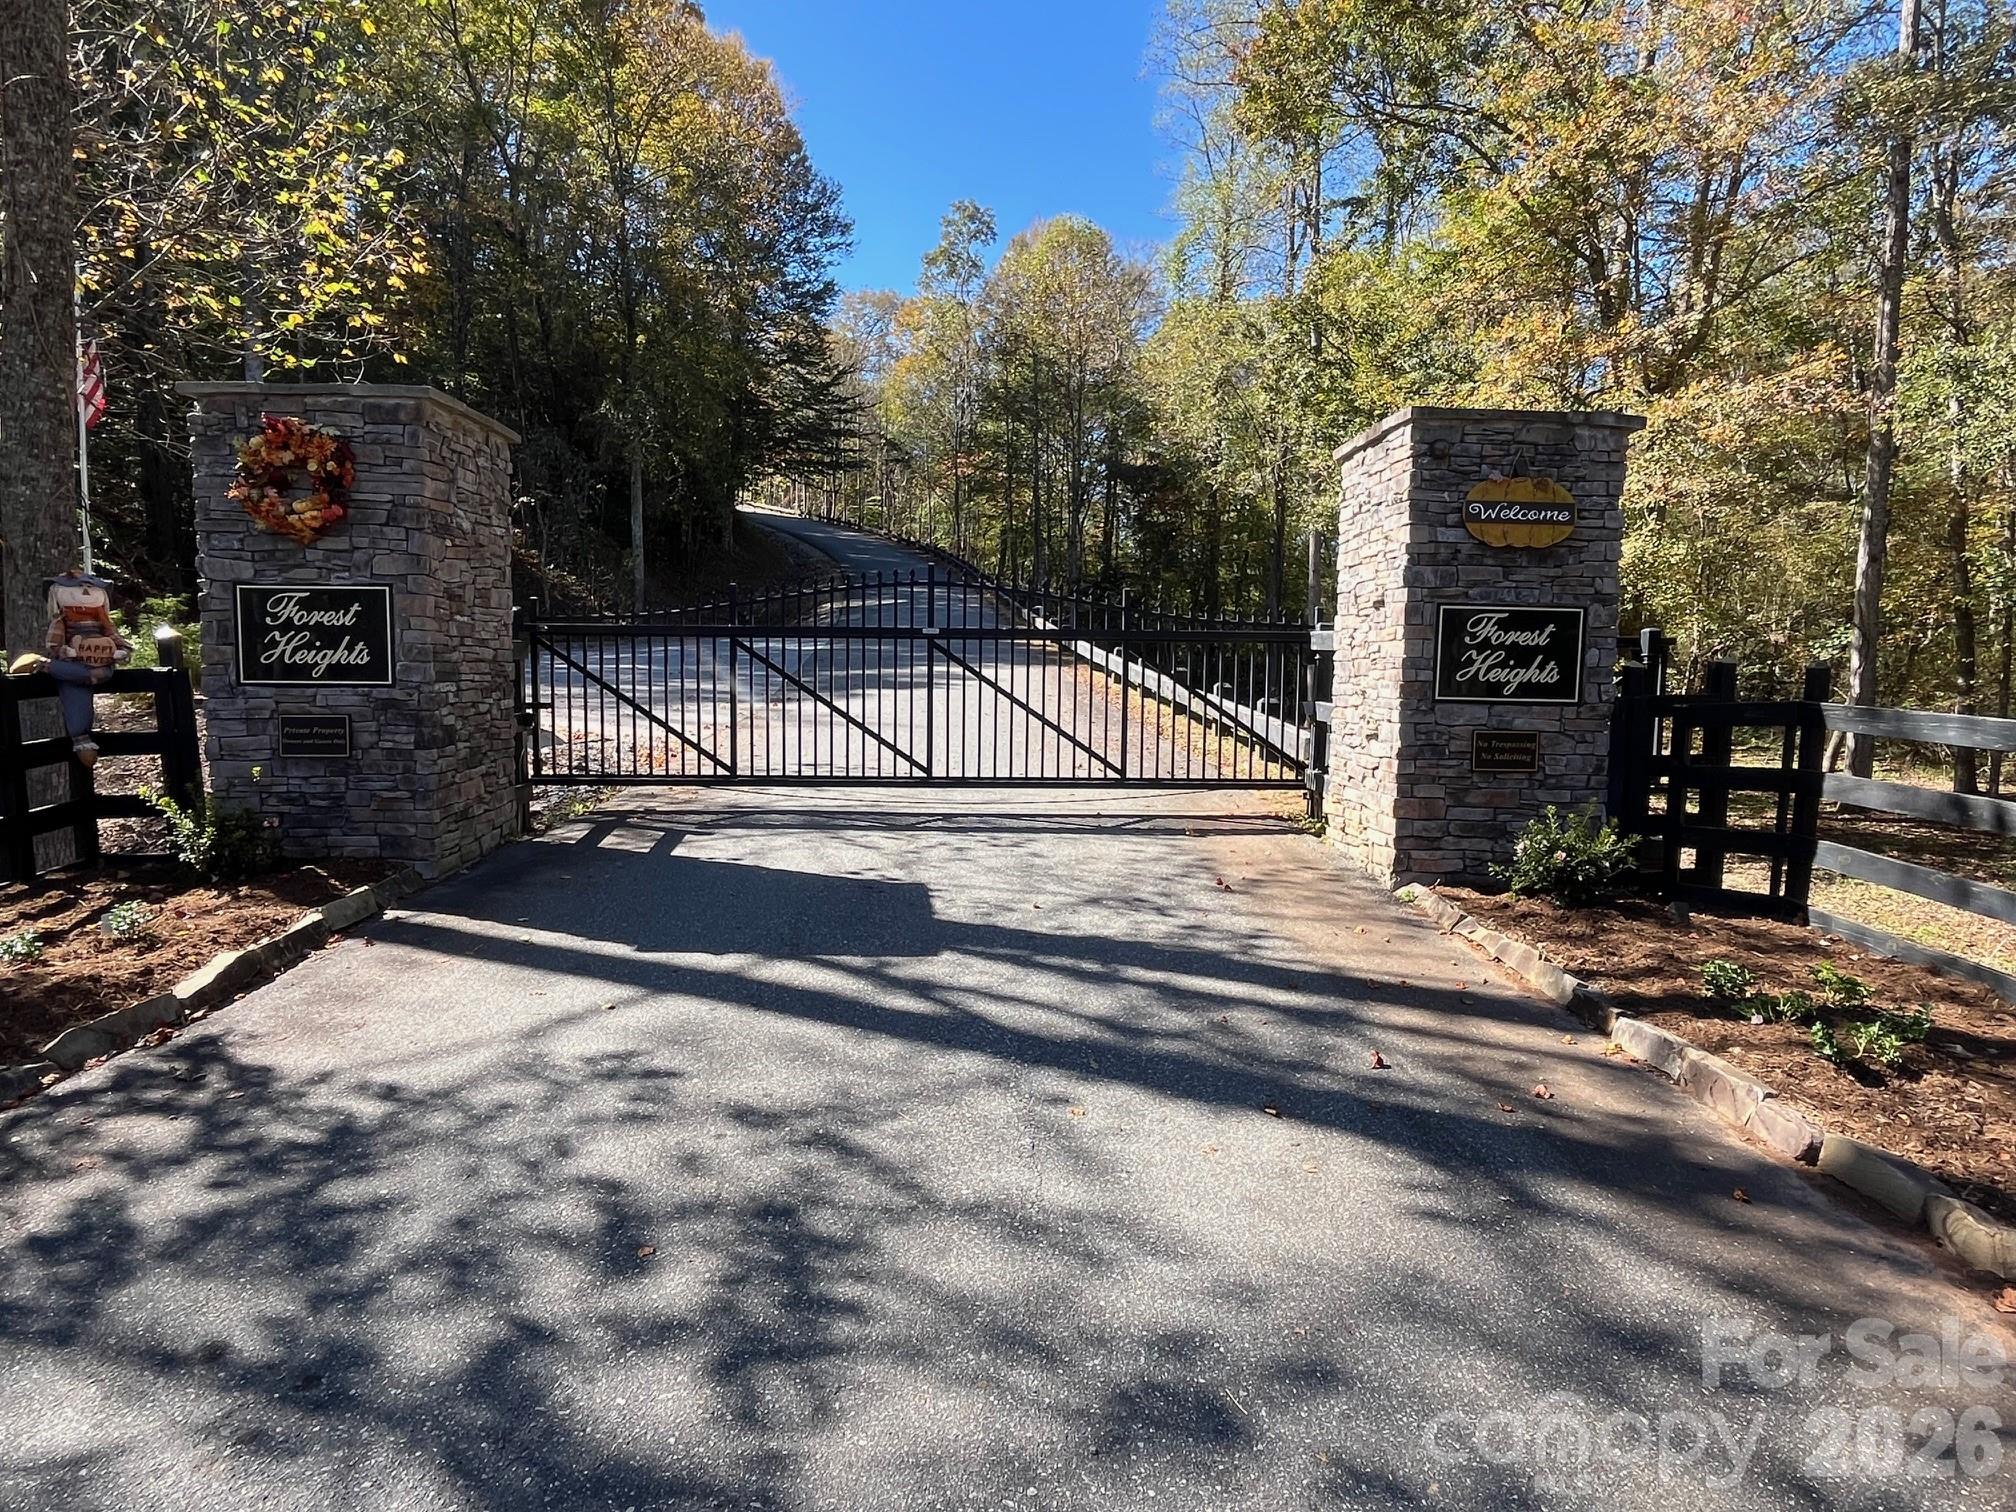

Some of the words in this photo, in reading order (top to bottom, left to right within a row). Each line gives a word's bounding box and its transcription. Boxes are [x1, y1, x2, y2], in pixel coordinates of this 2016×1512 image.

[1469, 503, 1571, 521] Welcome
[265, 592, 362, 625] Forest
[1464, 613, 1556, 645] Forest
[260, 631, 370, 677] Heights
[1456, 650, 1560, 695] Heights
[1481, 752, 1492, 760] No
